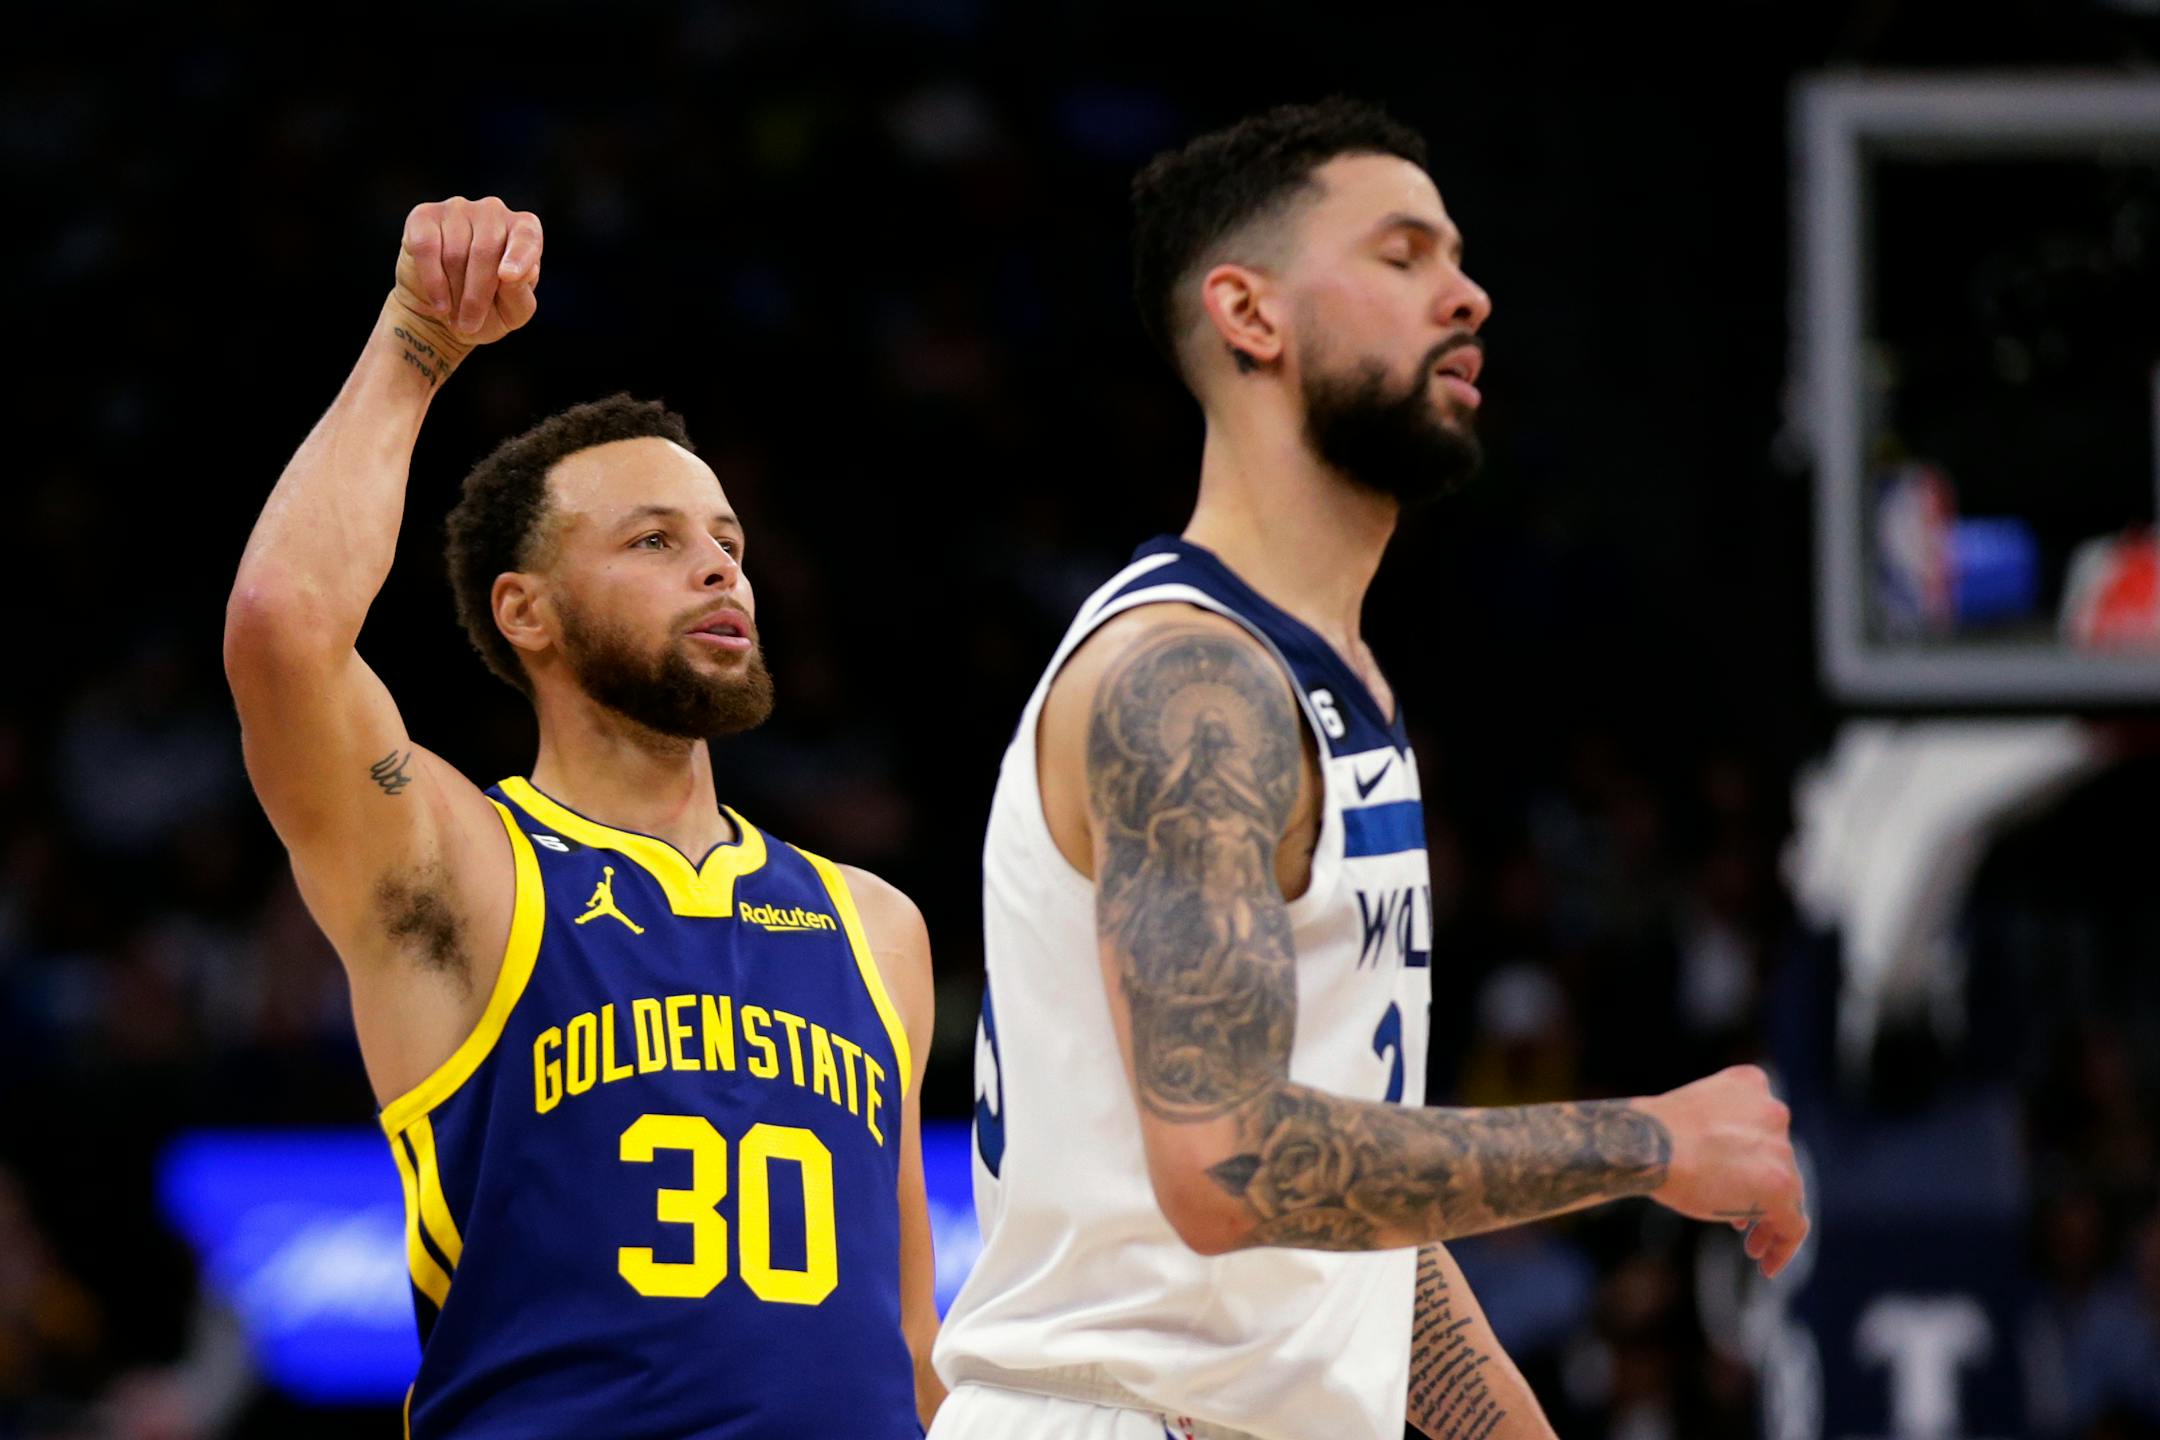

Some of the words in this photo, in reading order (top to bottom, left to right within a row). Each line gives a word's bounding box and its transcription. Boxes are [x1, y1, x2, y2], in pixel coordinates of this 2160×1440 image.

[1309, 688, 1345, 739] 6
[738, 901, 837, 931] Rakuten
[533, 994, 736, 1115] GOLDEN
[740, 1004, 886, 1148] STATE
[618, 1113, 838, 1306] 30
